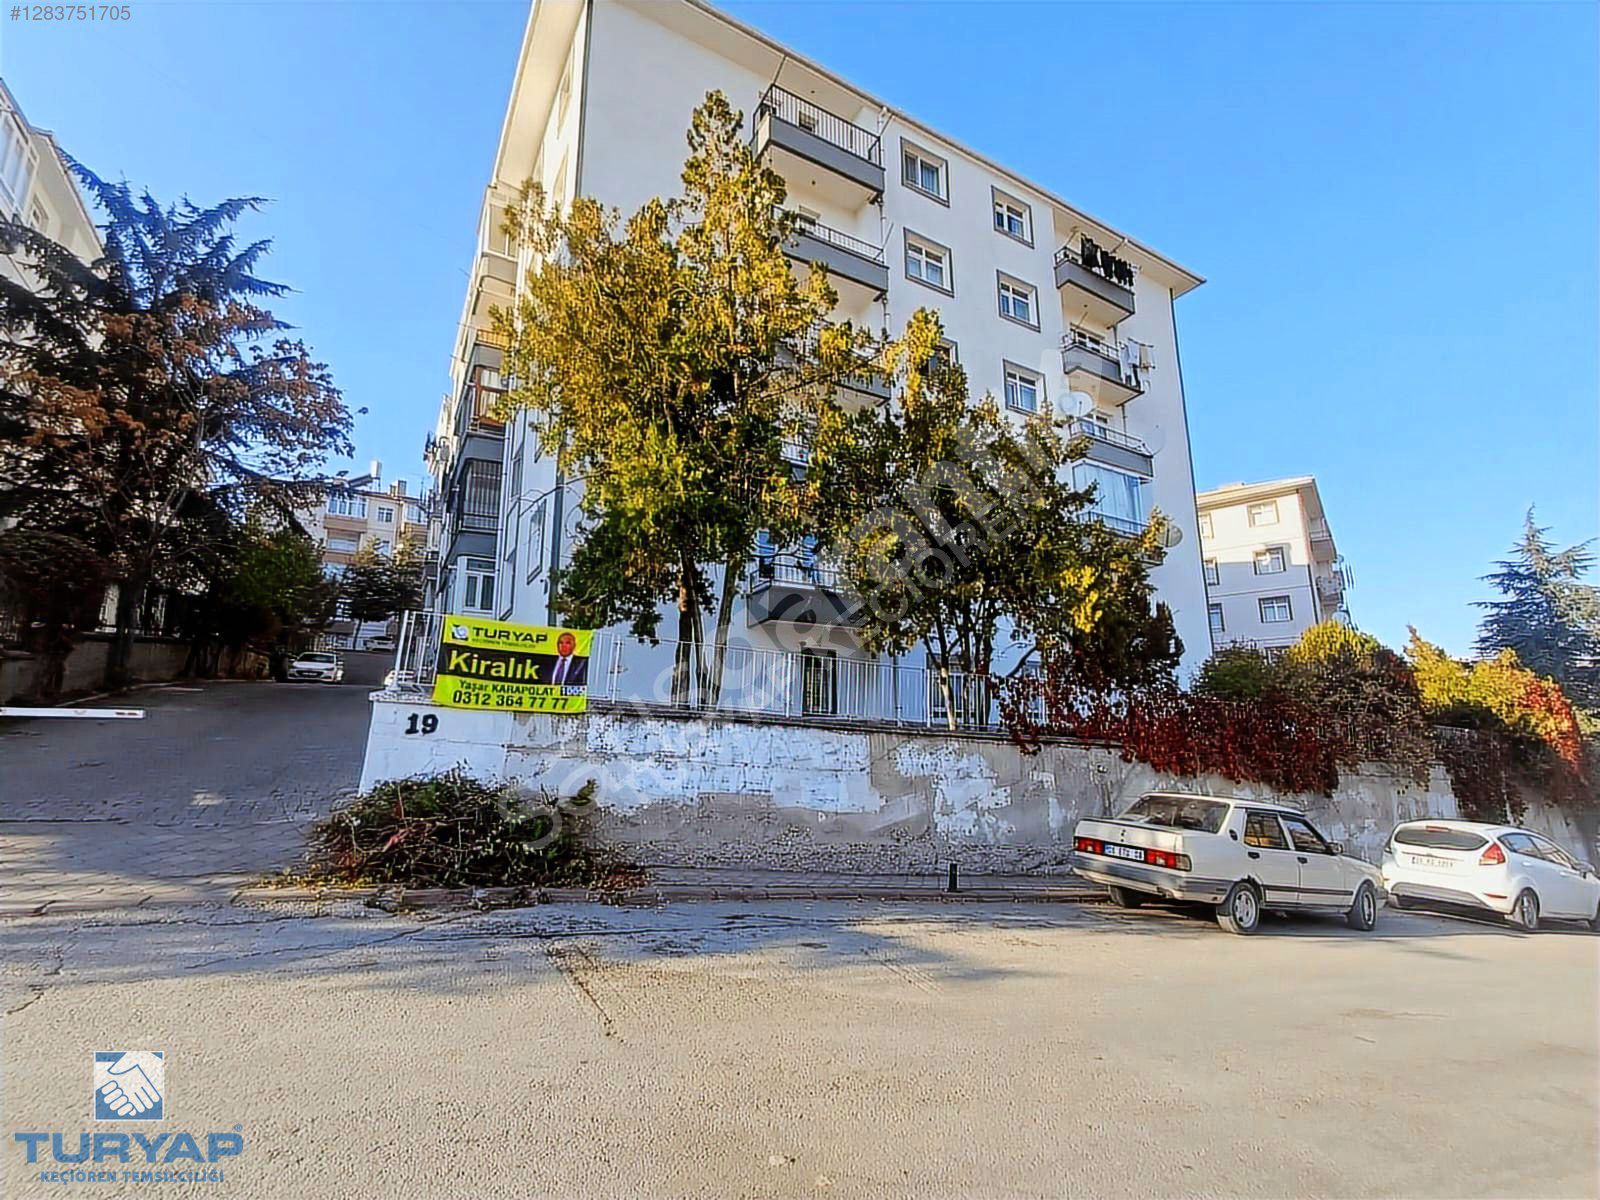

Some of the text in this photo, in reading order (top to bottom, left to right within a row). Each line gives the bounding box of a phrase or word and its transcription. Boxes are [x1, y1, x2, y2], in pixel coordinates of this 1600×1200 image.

[472, 626, 548, 644] TURYAP
[449, 650, 541, 680] Kiralık
[491, 683, 555, 696] KARAPOLAT
[453, 690, 569, 710] 0312 364 77 77
[405, 712, 439, 736] 19
